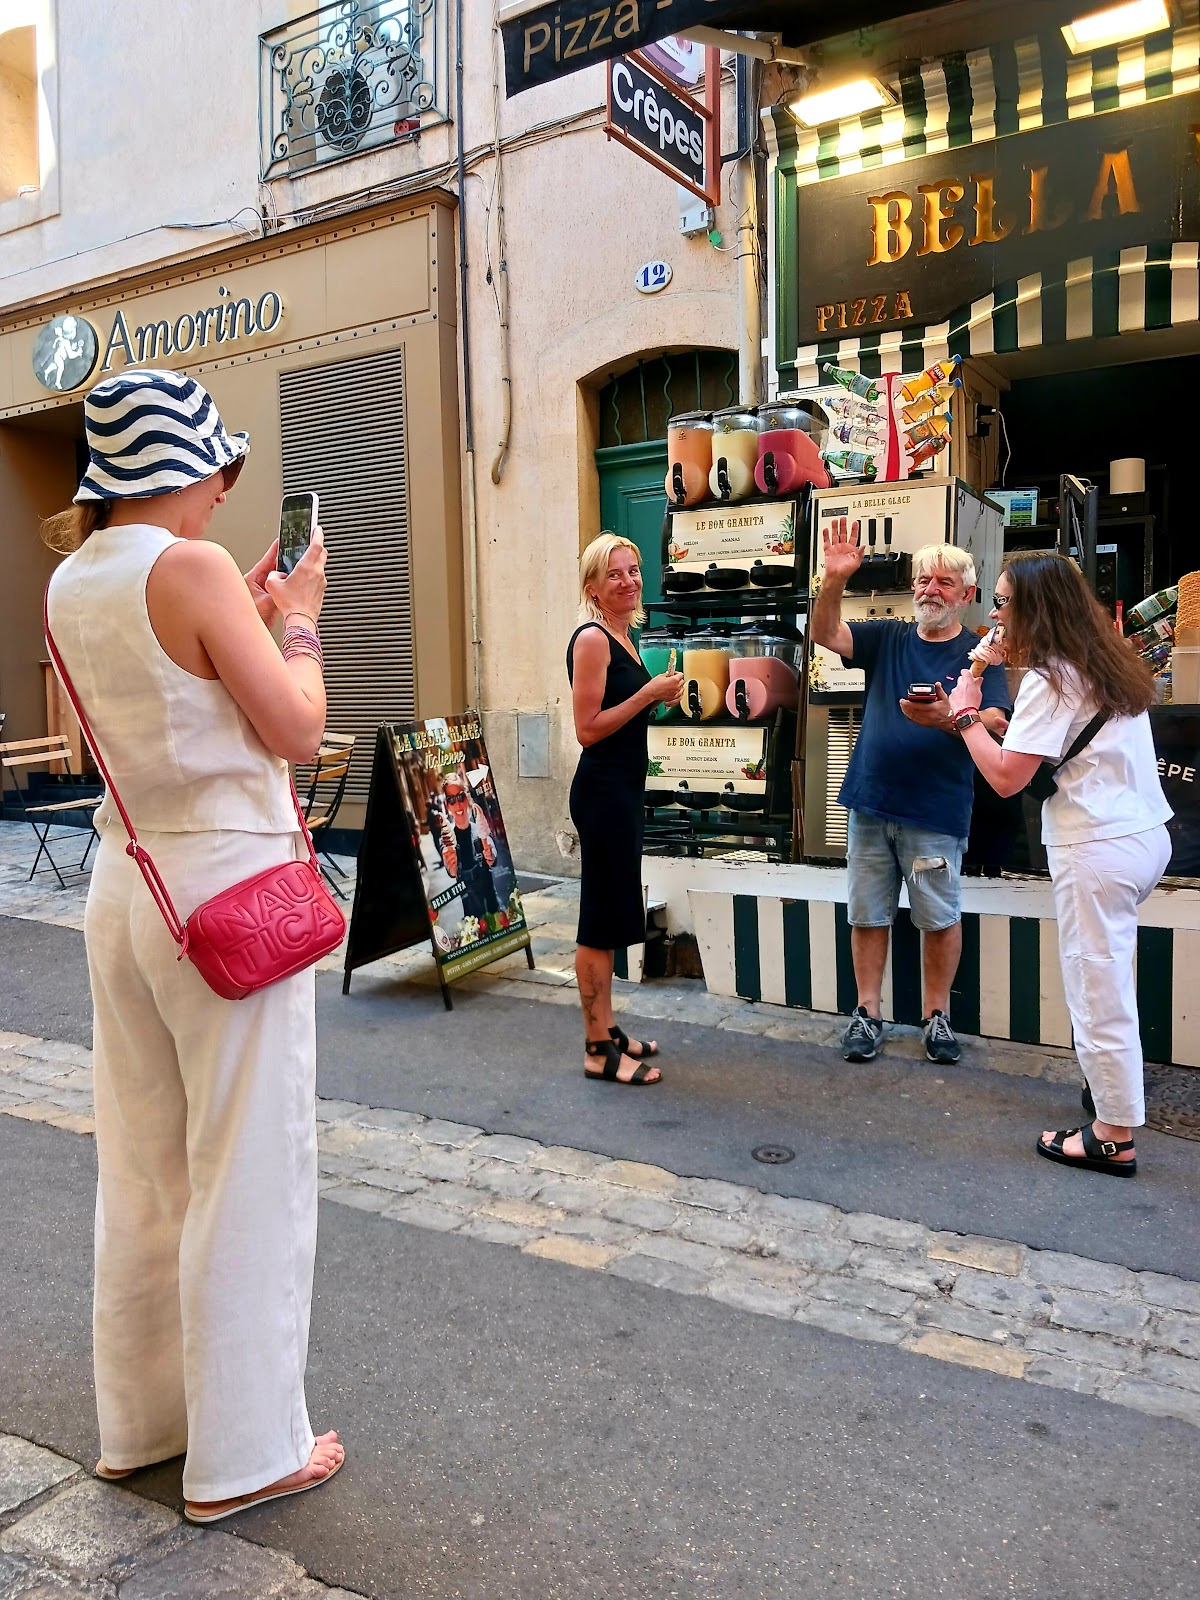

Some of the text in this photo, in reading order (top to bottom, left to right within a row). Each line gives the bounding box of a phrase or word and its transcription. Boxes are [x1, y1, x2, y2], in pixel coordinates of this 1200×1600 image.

[523, 0, 640, 73] Pizza
[612, 62, 702, 166] Crêpes
[866, 138, 1140, 267] BELLA
[640, 264, 666, 288] 12
[100, 286, 283, 372] Amorino
[815, 289, 915, 333] PIZZA
[864, 498, 886, 507] BELLE
[888, 496, 911, 505] GLACE
[696, 516, 765, 530] LE BON GRANITA
[393, 722, 480, 753] LA BELLE GLACE
[667, 737, 736, 748] LE BON GRANITA
[1157, 758, 1196, 783] ÊPE
[210, 870, 314, 942] NAU
[431, 881, 467, 910] BELLA VITA
[224, 902, 343, 976] TICA
